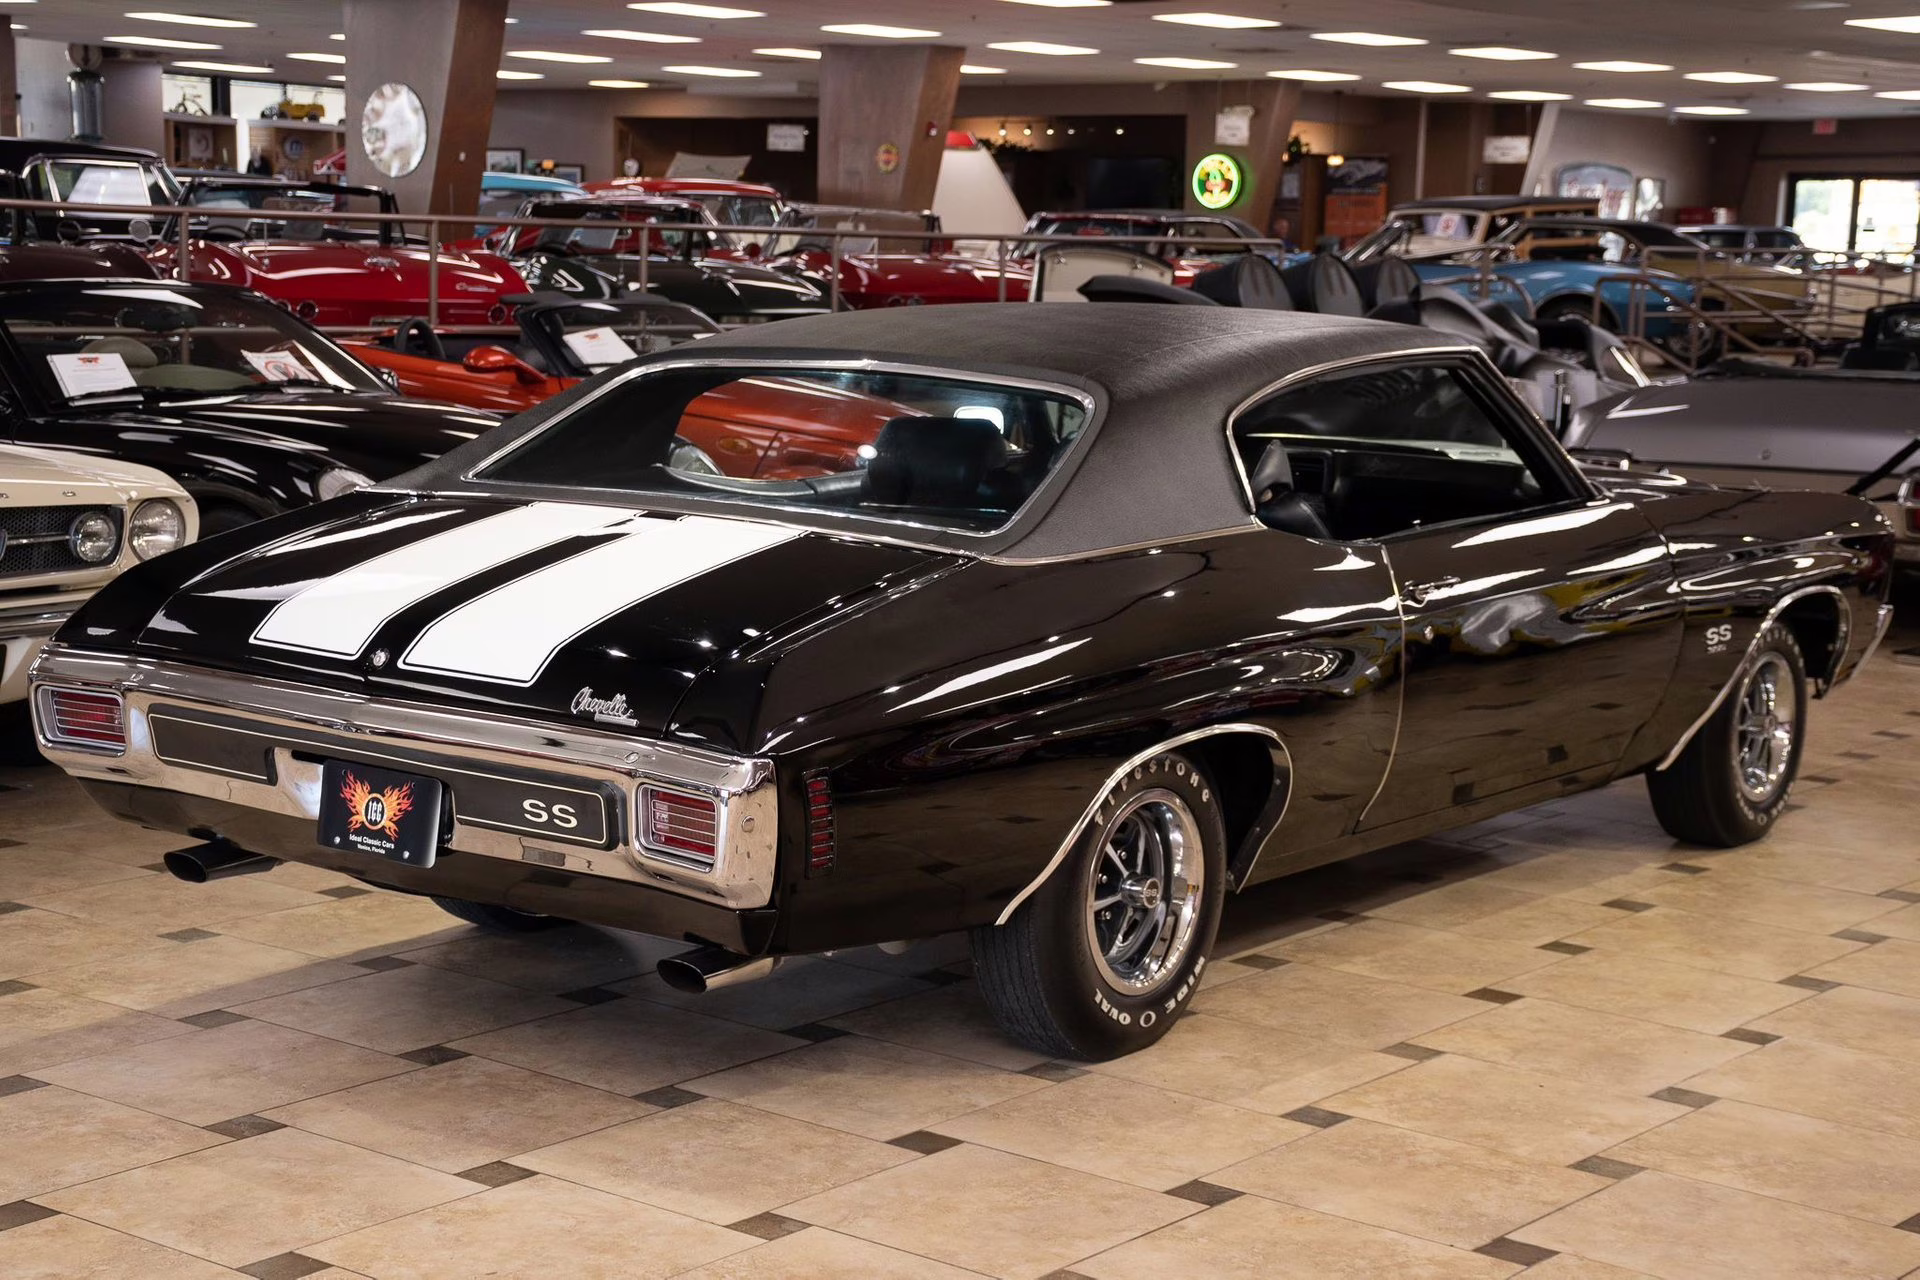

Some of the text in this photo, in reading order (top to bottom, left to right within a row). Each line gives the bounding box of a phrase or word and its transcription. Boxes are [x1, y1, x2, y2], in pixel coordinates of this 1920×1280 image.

[1705, 623, 1732, 645] SS
[570, 686, 634, 719] Chevelle
[1094, 757, 1211, 826] Firestone
[522, 798, 578, 828] SS
[349, 834, 394, 849] Ideal Classic Cars
[1094, 987, 1132, 1025] OVAL
